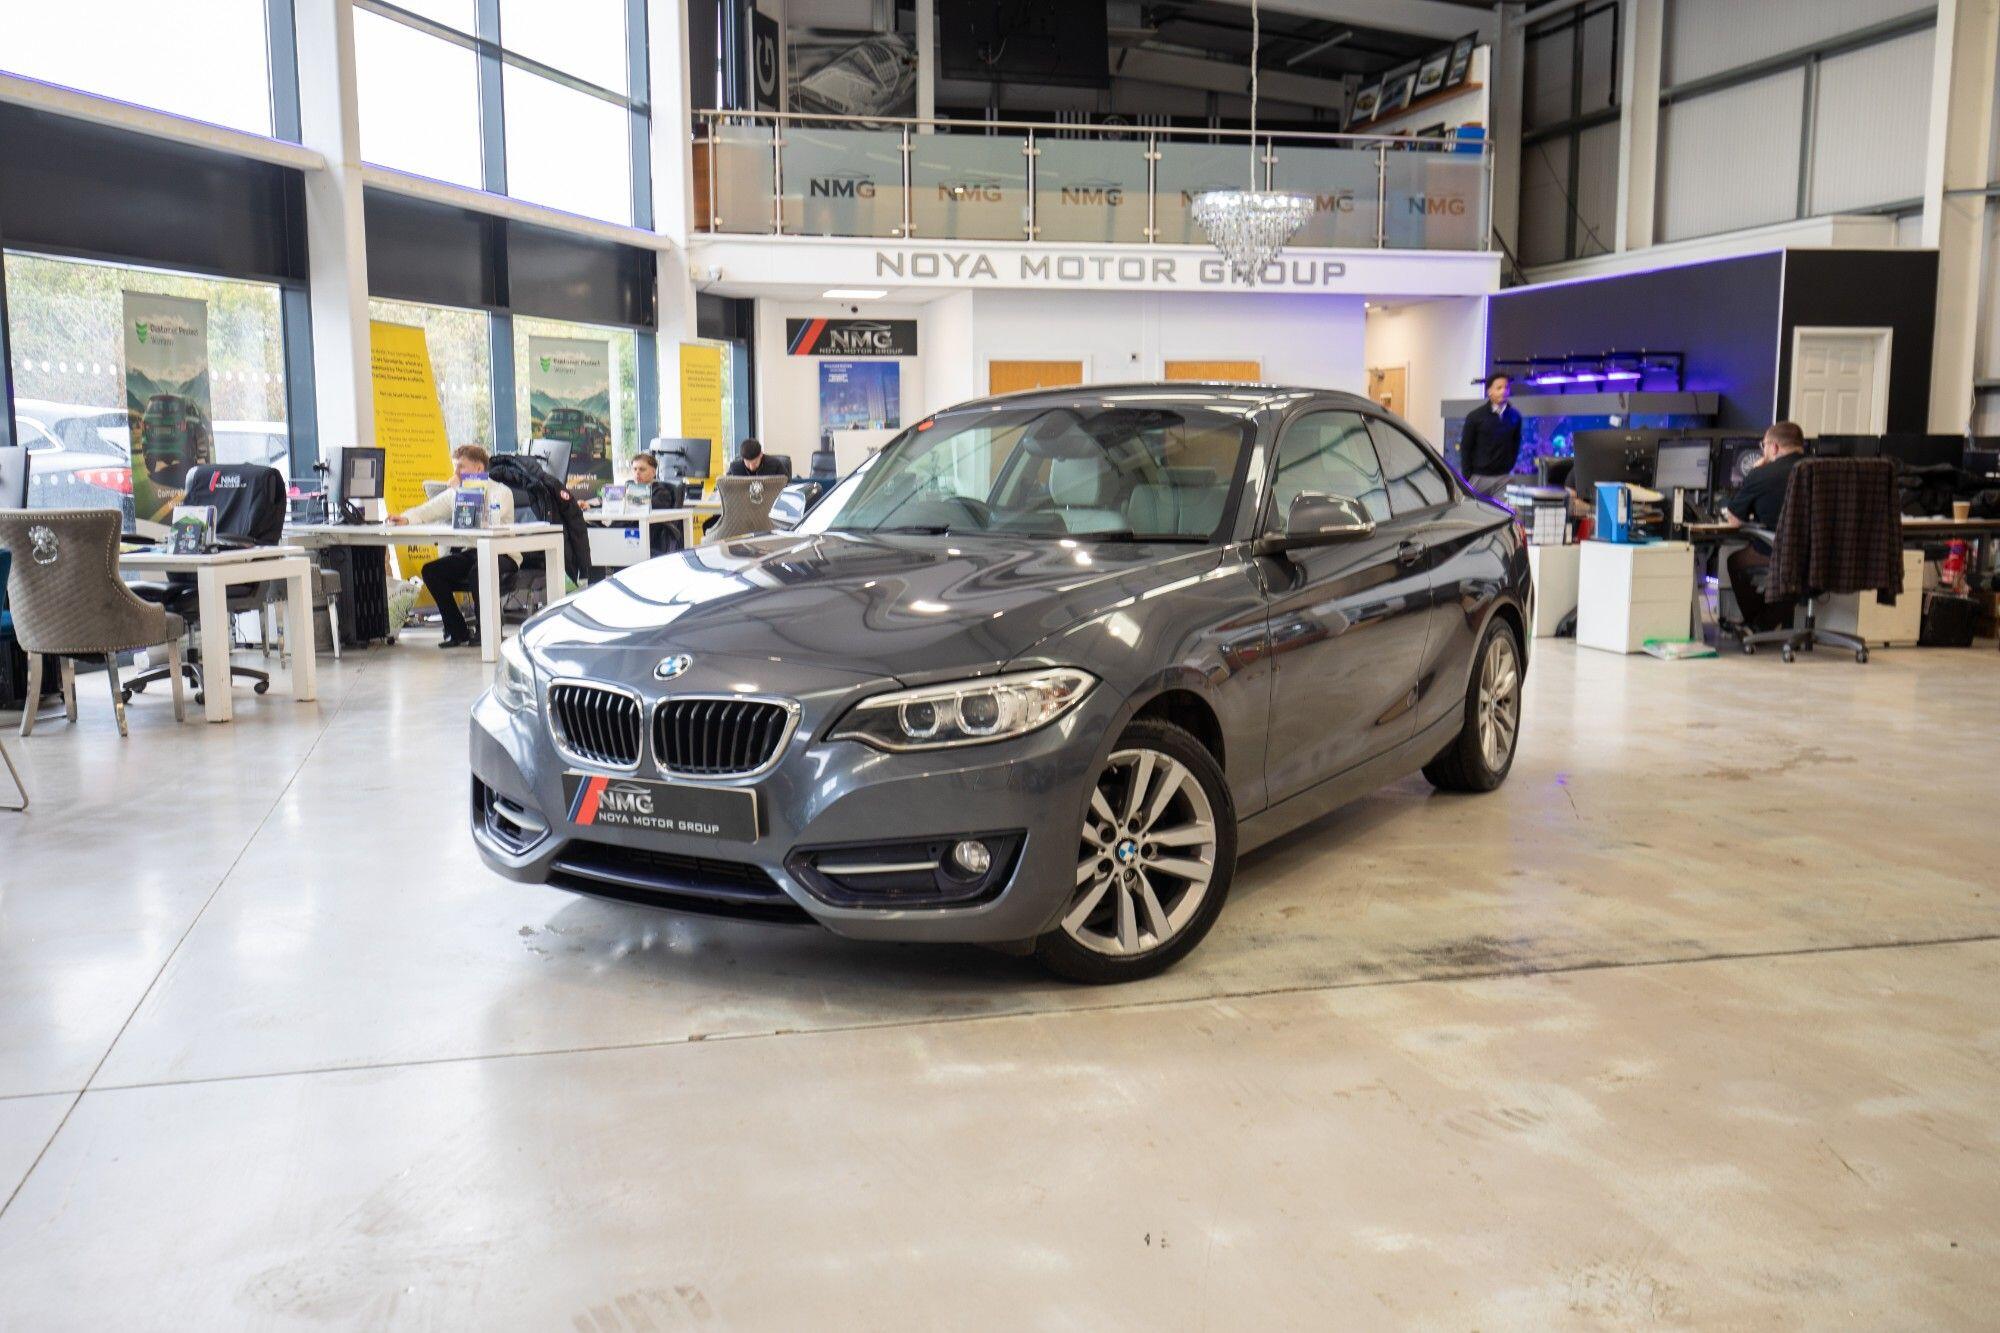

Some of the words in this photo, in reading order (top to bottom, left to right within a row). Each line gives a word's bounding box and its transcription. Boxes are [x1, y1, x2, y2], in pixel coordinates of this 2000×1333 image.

[810, 178, 876, 199] NMG
[938, 182, 1002, 202] NMG
[1061, 186, 1124, 206] NMG
[1315, 193, 1355, 214] MG
[1408, 196, 1466, 216] NMG
[876, 251, 998, 280] NOYA
[1020, 255, 1177, 284] MOTOR
[829, 329, 893, 349] NMG
[819, 347, 840, 355] NOYA
[597, 789, 654, 815] NMG
[598, 812, 630, 825] NOYA
[632, 815, 674, 830] MOTOR
[678, 820, 720, 834] GROUP
